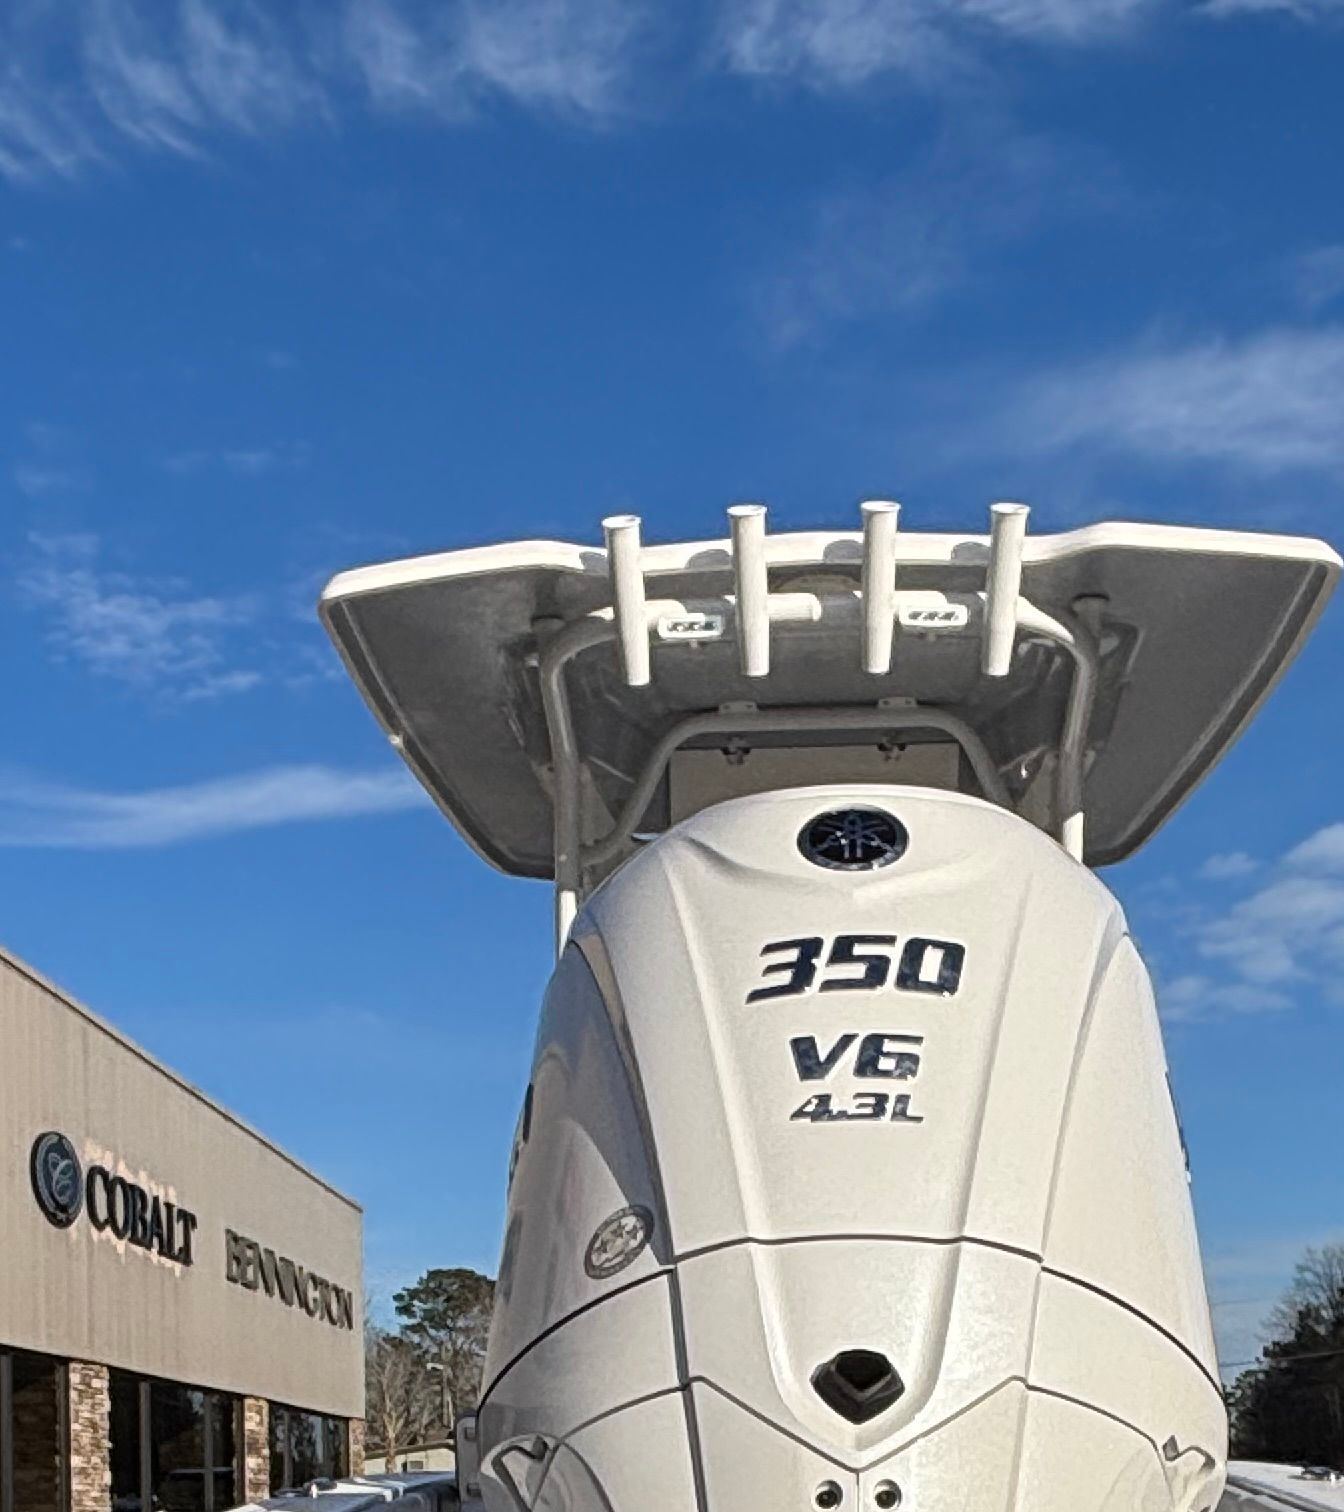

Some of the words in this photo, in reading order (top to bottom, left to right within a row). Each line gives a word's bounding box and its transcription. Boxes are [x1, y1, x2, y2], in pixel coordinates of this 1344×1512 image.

[744, 935, 966, 1004] 350
[789, 1033, 924, 1082] V6
[789, 1092, 924, 1123] 4.3L
[86, 1165, 197, 1267] COBALT
[225, 1228, 353, 1331] BENNINGTON
